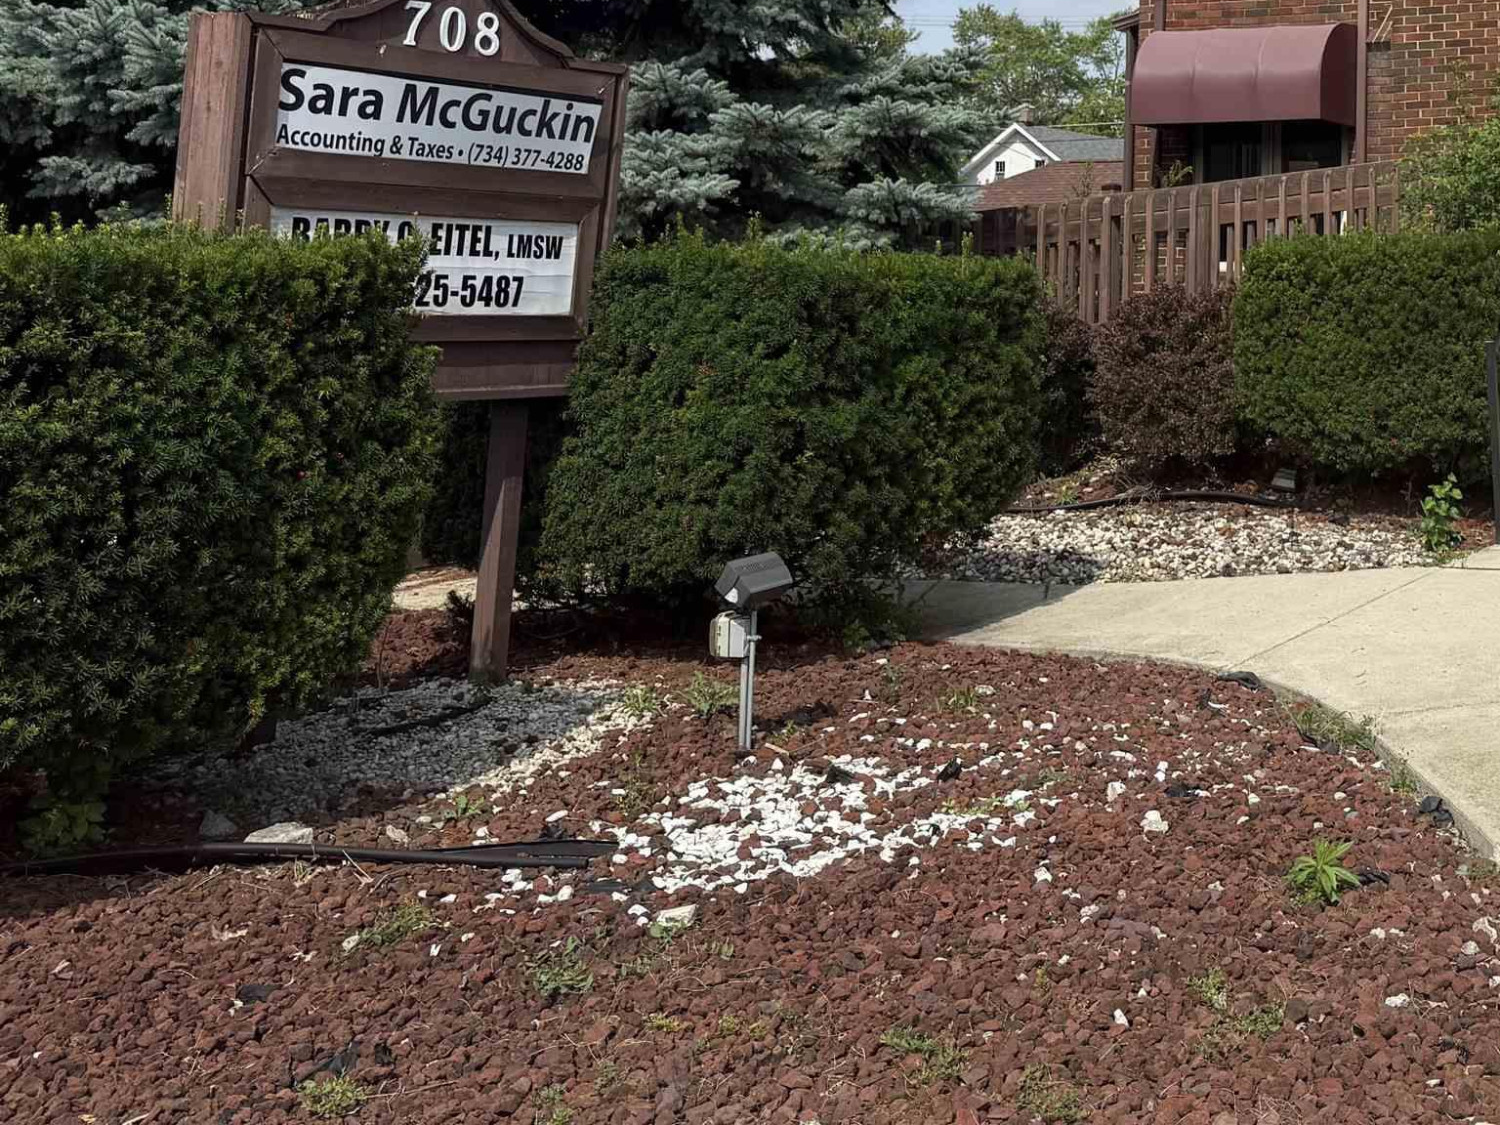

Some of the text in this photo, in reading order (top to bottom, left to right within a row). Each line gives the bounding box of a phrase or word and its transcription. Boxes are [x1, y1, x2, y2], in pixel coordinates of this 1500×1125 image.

[403, 0, 500, 56] 708
[278, 68, 595, 143] Sara McGuckin
[276, 124, 585, 171] Accounting & Taxes (734) 377-4288
[430, 223, 500, 261] EITEL,
[506, 233, 564, 260] LMSW
[403, 273, 524, 308] 25-5487
